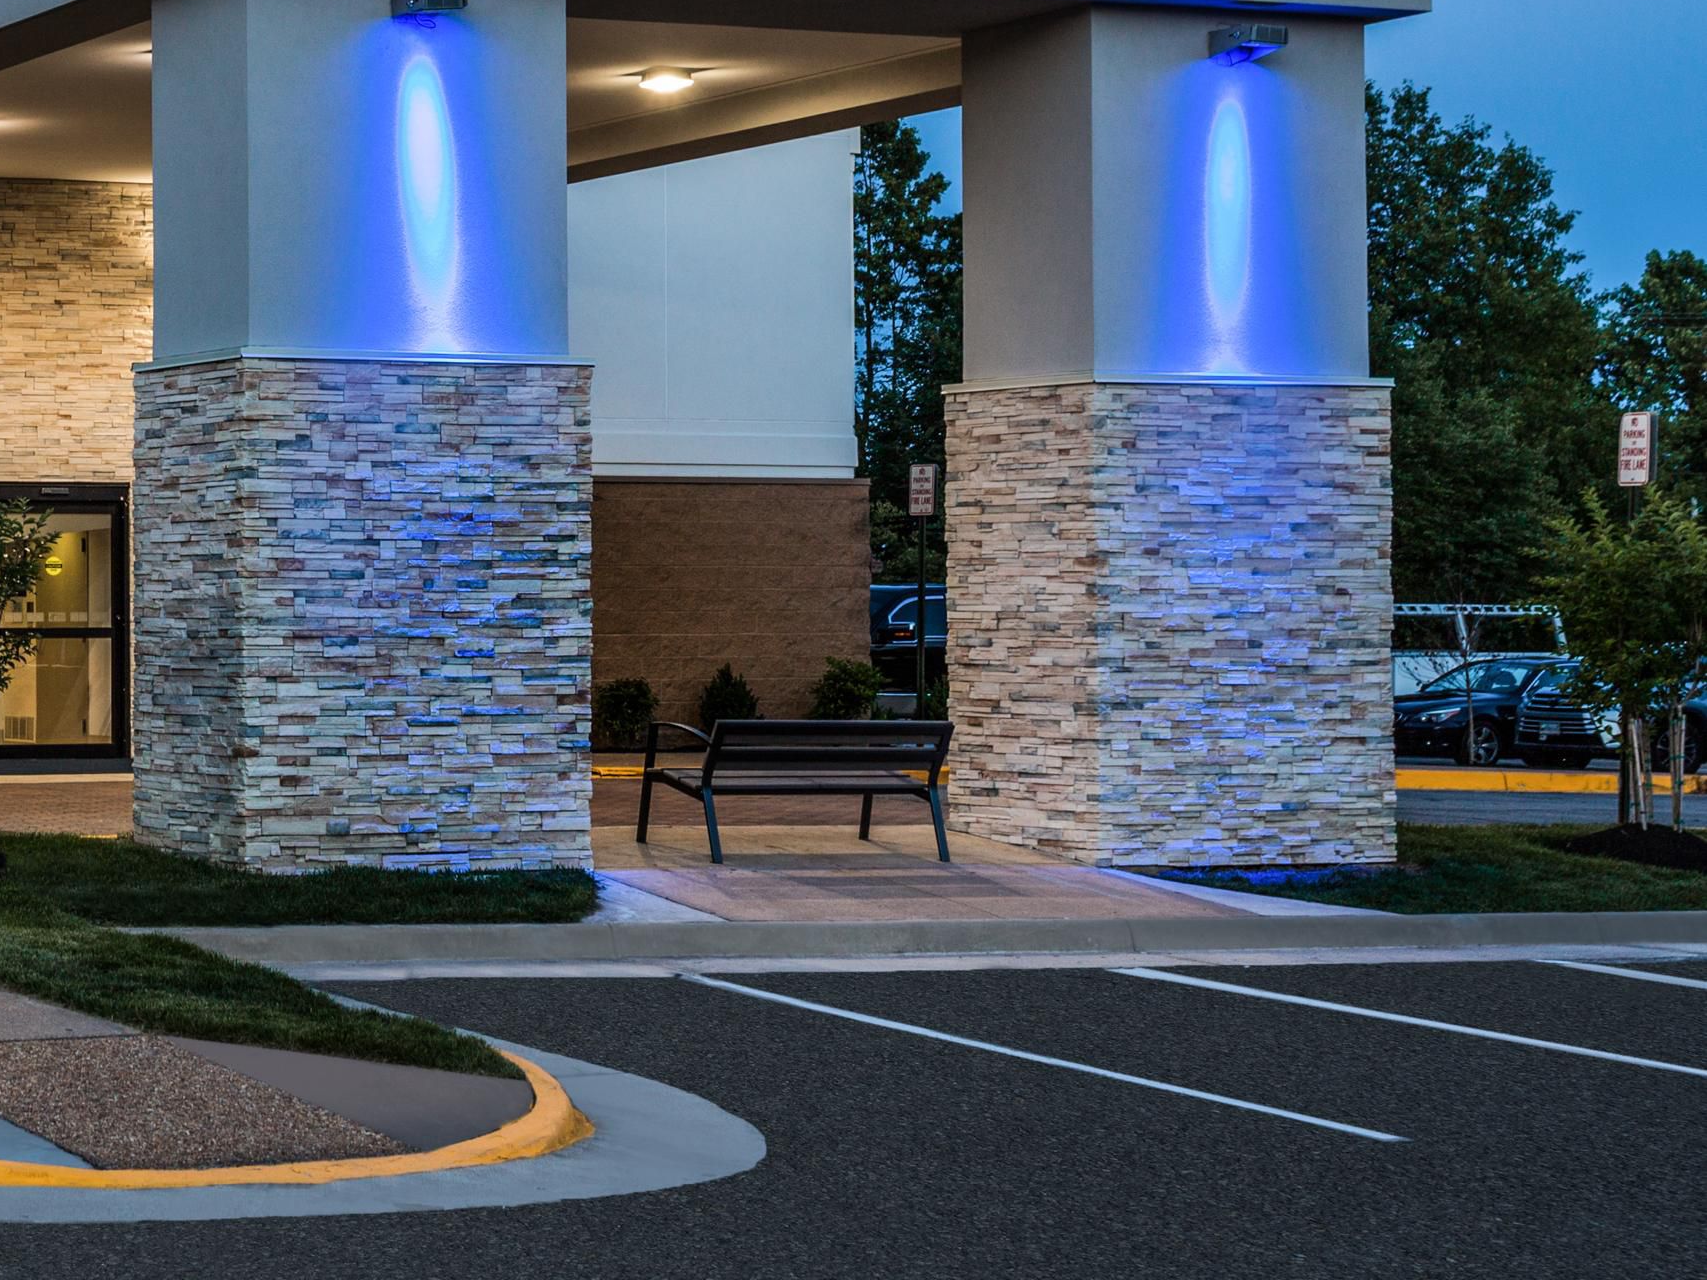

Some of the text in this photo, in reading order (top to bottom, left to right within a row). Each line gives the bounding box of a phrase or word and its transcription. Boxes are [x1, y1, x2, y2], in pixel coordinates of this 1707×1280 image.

[1623, 430, 1645, 439] PARKING
[1622, 448, 1646, 456] STANDING
[1621, 459, 1645, 470] FIRE LANE
